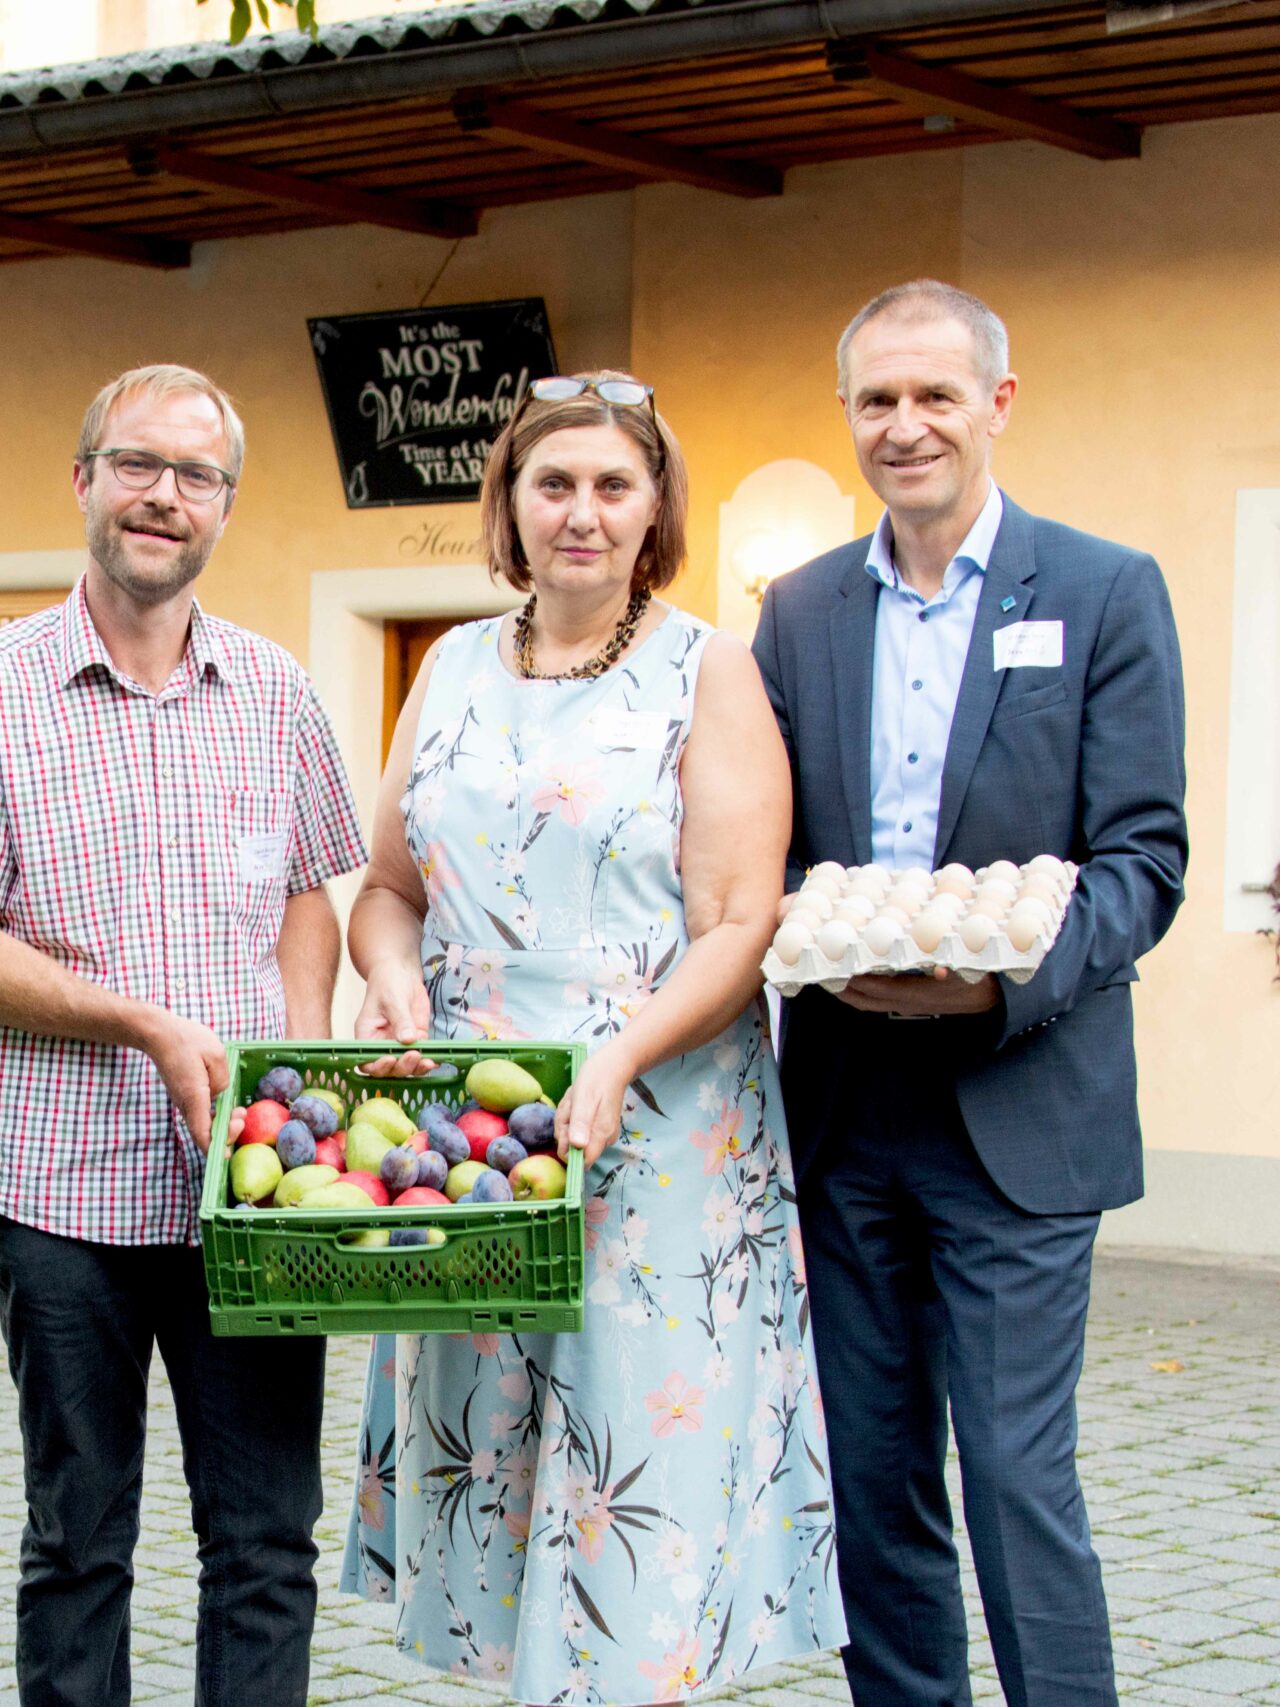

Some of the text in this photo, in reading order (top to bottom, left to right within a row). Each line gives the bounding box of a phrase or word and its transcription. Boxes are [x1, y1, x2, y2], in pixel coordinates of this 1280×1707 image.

[399, 321, 461, 343] It's the
[378, 339, 483, 379] MOST
[358, 366, 529, 443] Wonderful
[399, 438, 493, 463] Time of th
[414, 457, 484, 486] YEAR
